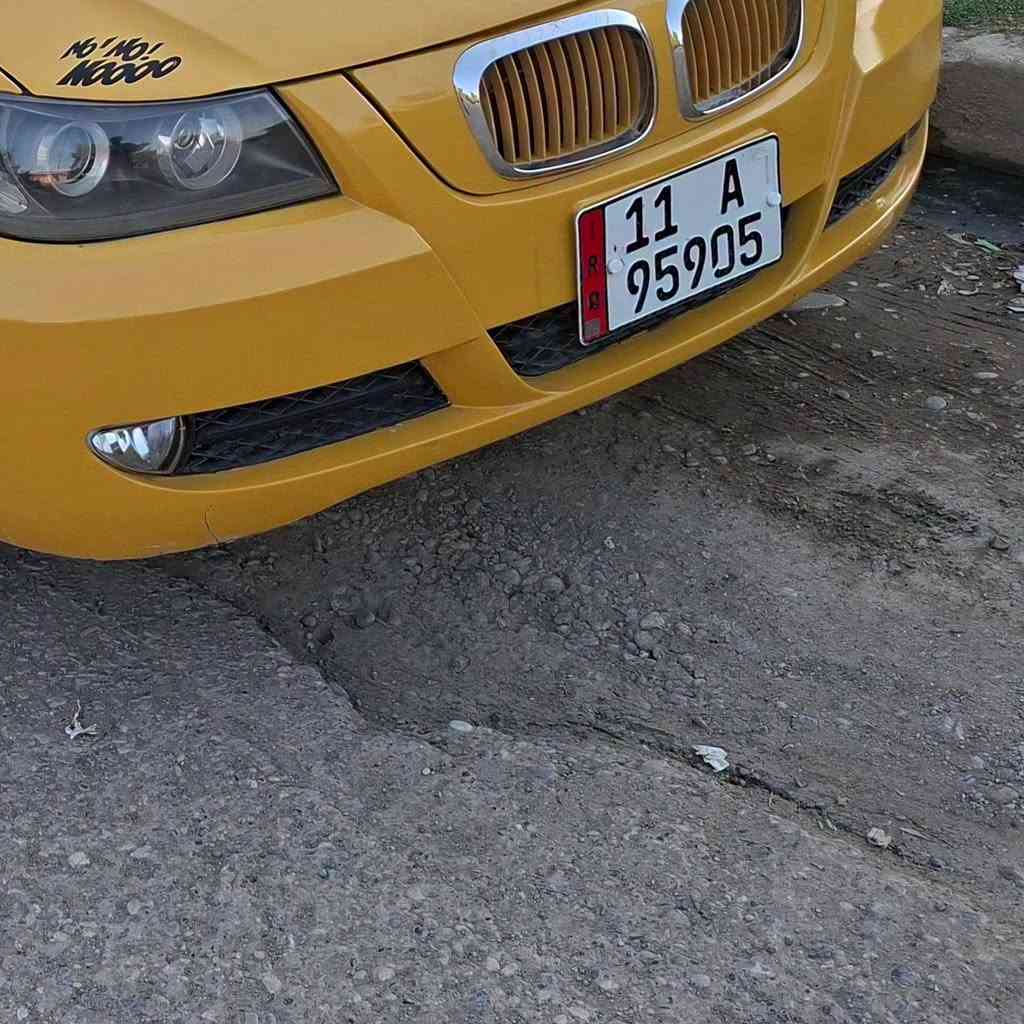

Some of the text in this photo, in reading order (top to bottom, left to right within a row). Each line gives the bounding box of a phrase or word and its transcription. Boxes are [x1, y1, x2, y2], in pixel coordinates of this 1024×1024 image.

[626, 158, 745, 254] 11 A
[627, 211, 763, 314] 95905
